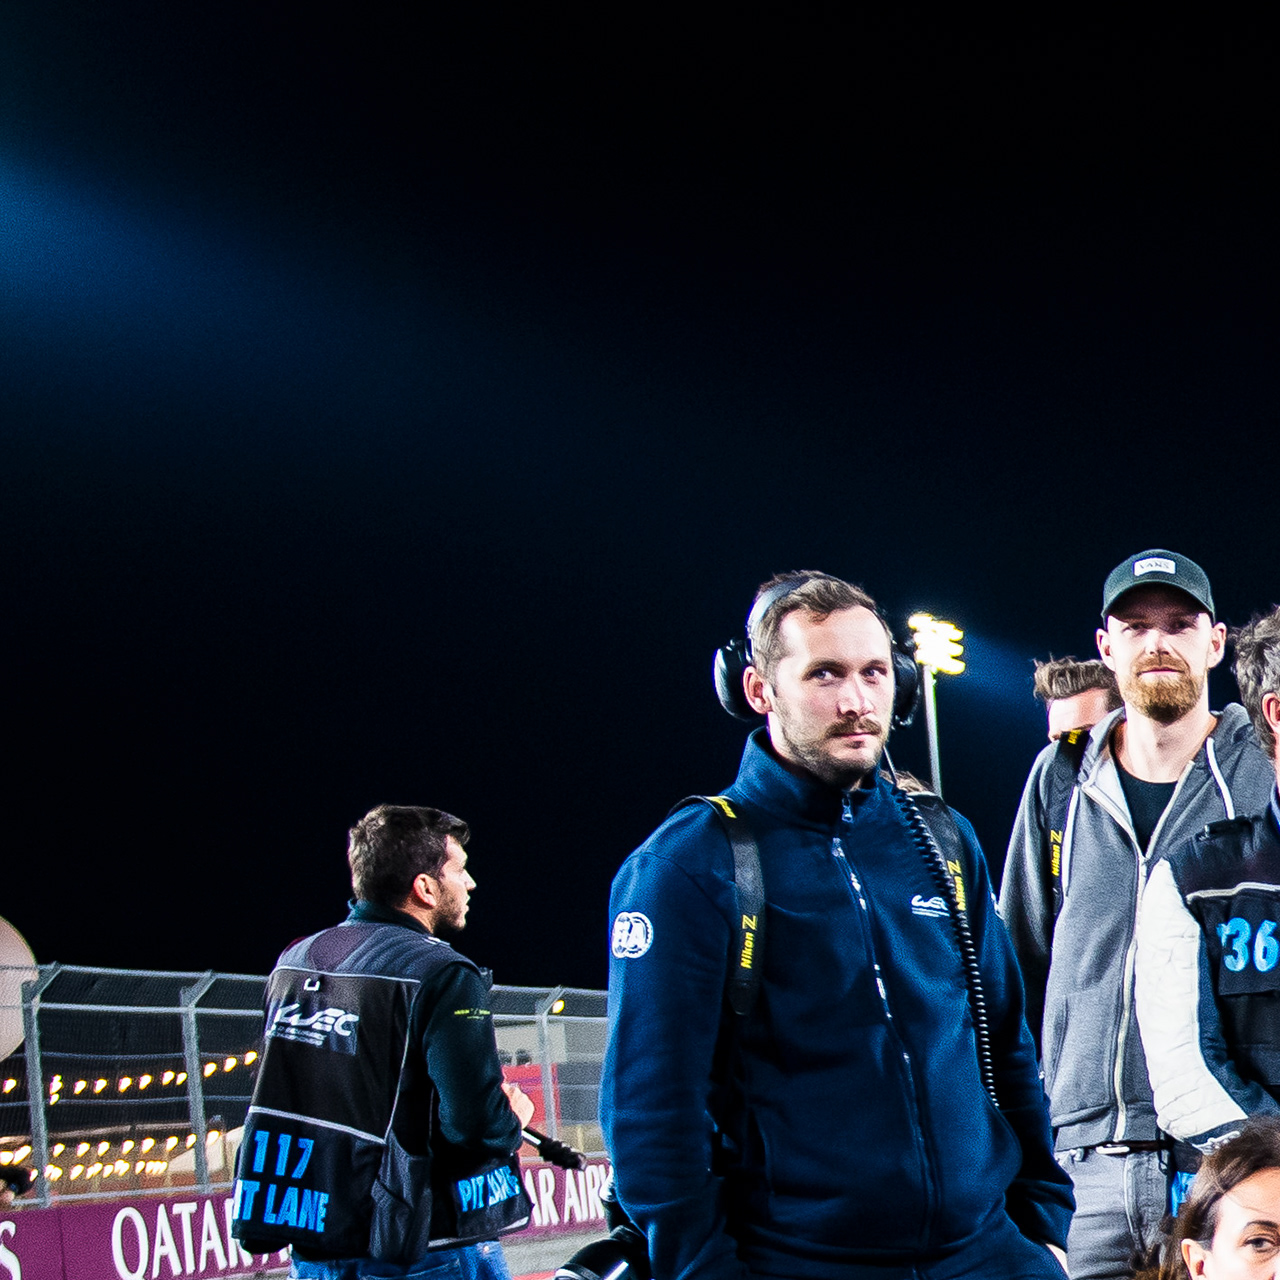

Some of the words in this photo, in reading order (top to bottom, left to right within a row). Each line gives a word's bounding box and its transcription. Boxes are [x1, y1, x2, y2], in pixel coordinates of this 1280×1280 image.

[741, 931, 755, 969] Nikon
[252, 1130, 314, 1179] 117
[233, 1179, 260, 1220] IT
[263, 1183, 330, 1233] LANE
[457, 1174, 487, 1212] PIT
